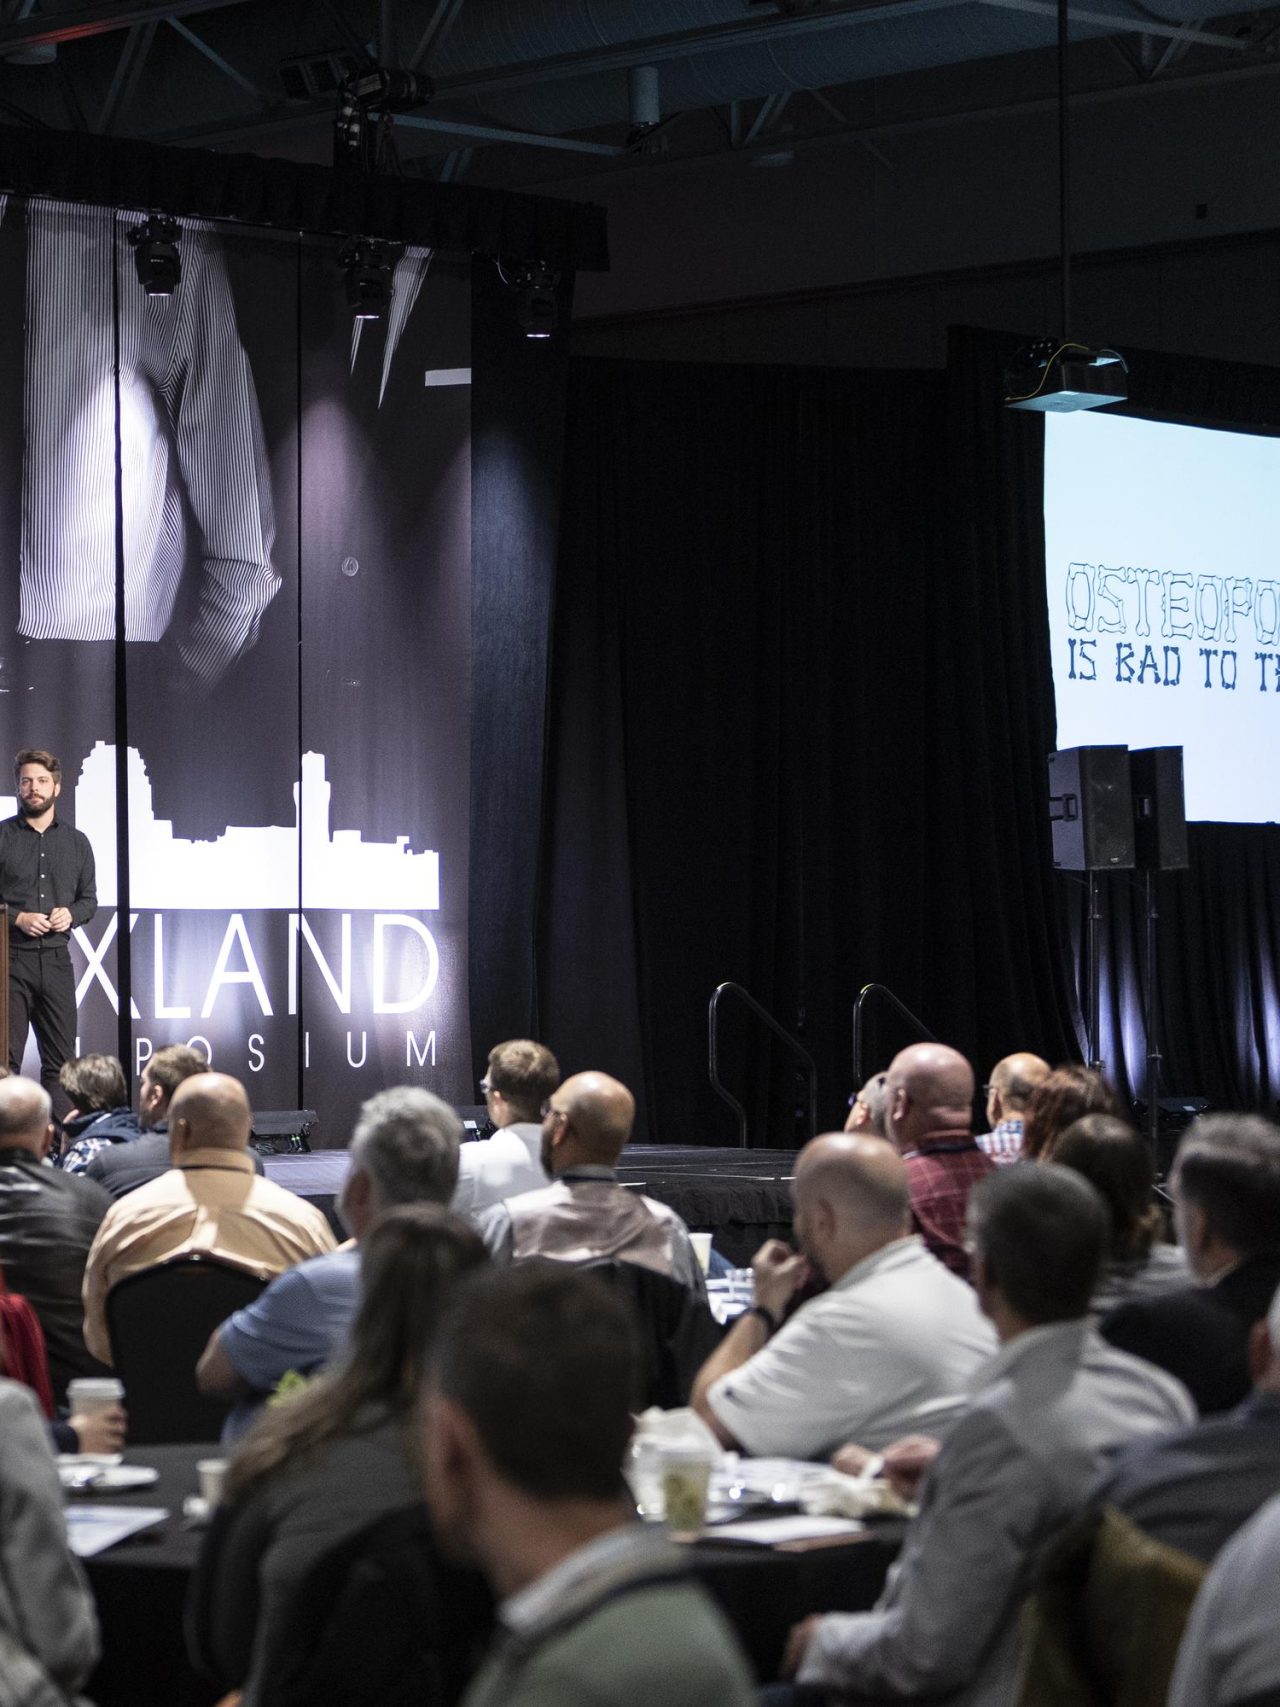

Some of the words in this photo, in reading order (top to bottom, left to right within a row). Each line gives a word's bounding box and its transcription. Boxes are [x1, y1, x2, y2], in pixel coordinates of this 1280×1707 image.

[1068, 638, 1097, 680] IS
[1116, 642, 1181, 686] BAD
[1199, 648, 1237, 690] TO
